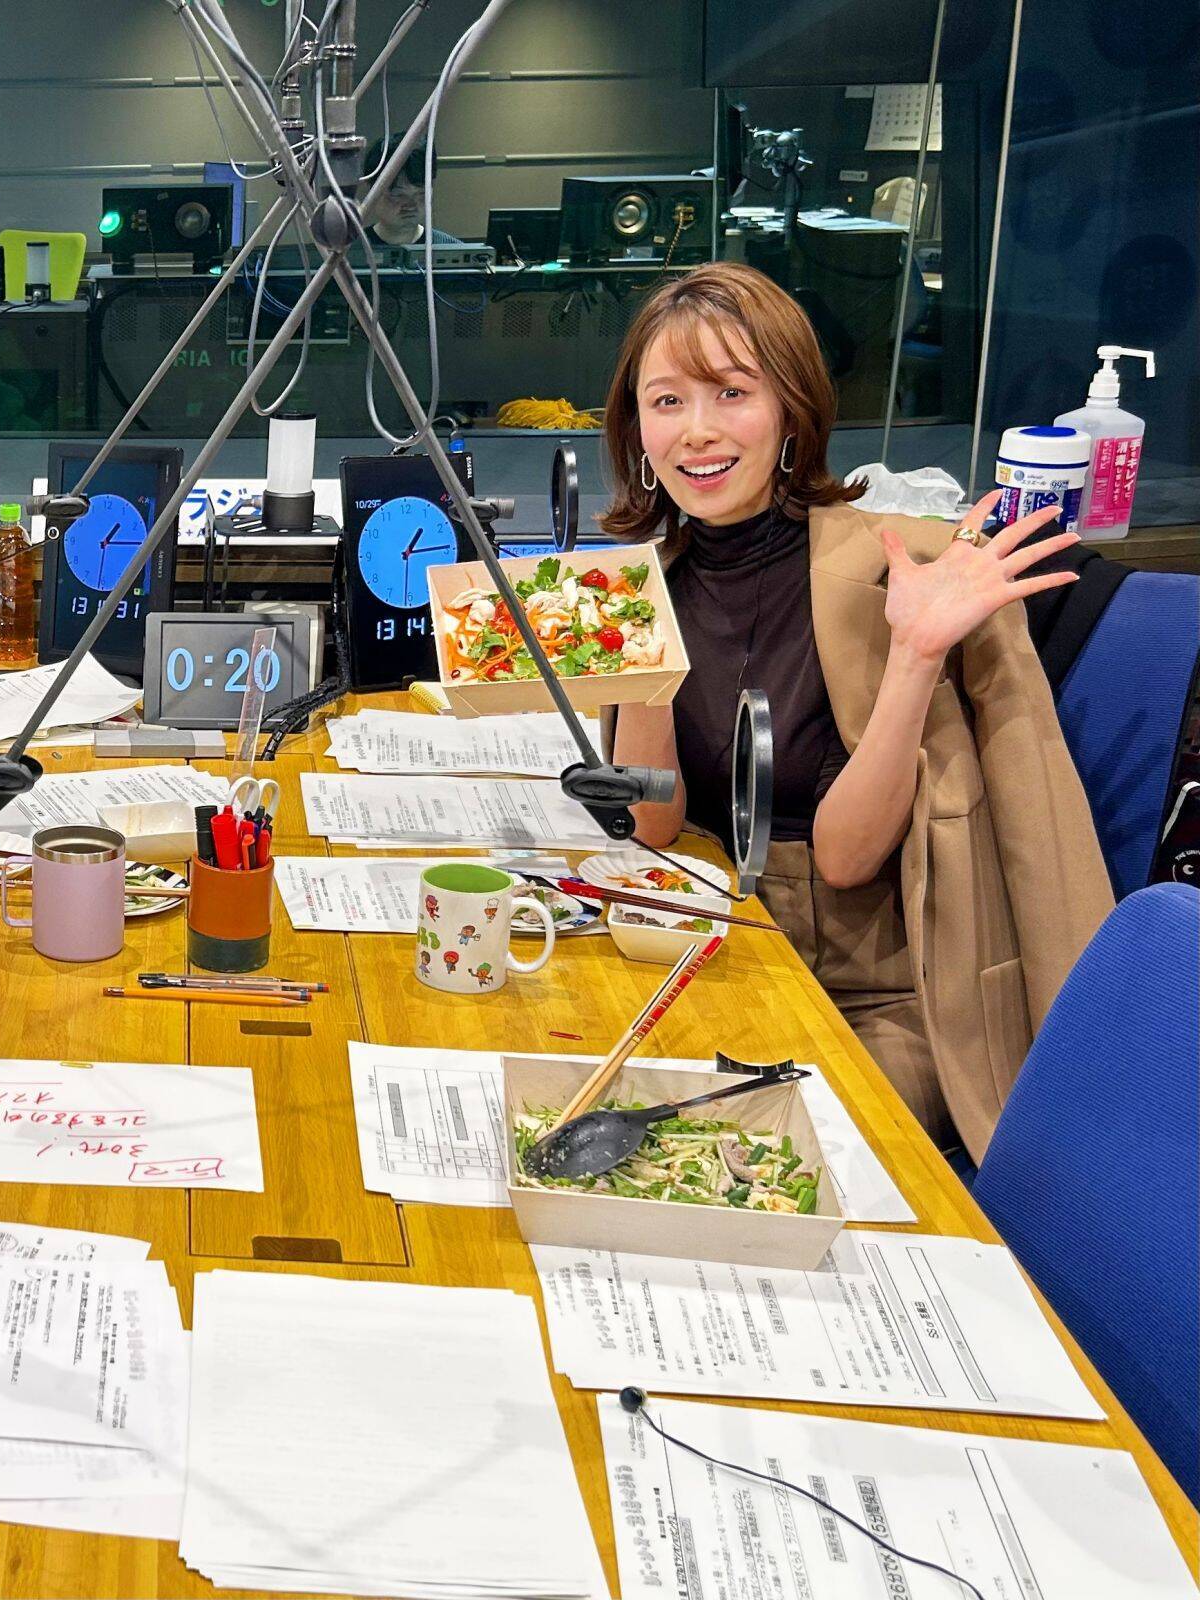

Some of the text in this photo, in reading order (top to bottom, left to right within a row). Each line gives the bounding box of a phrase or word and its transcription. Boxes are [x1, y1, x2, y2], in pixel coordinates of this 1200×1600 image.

[400, 504, 412, 515] 12
[380, 511, 392, 521] 11
[367, 529, 379, 539] 10
[437, 523, 444, 534] 2
[366, 551, 372, 562] 9
[372, 573, 379, 583] 8
[376, 617, 425, 640] 13 14
[166, 647, 281, 692] 0:20
